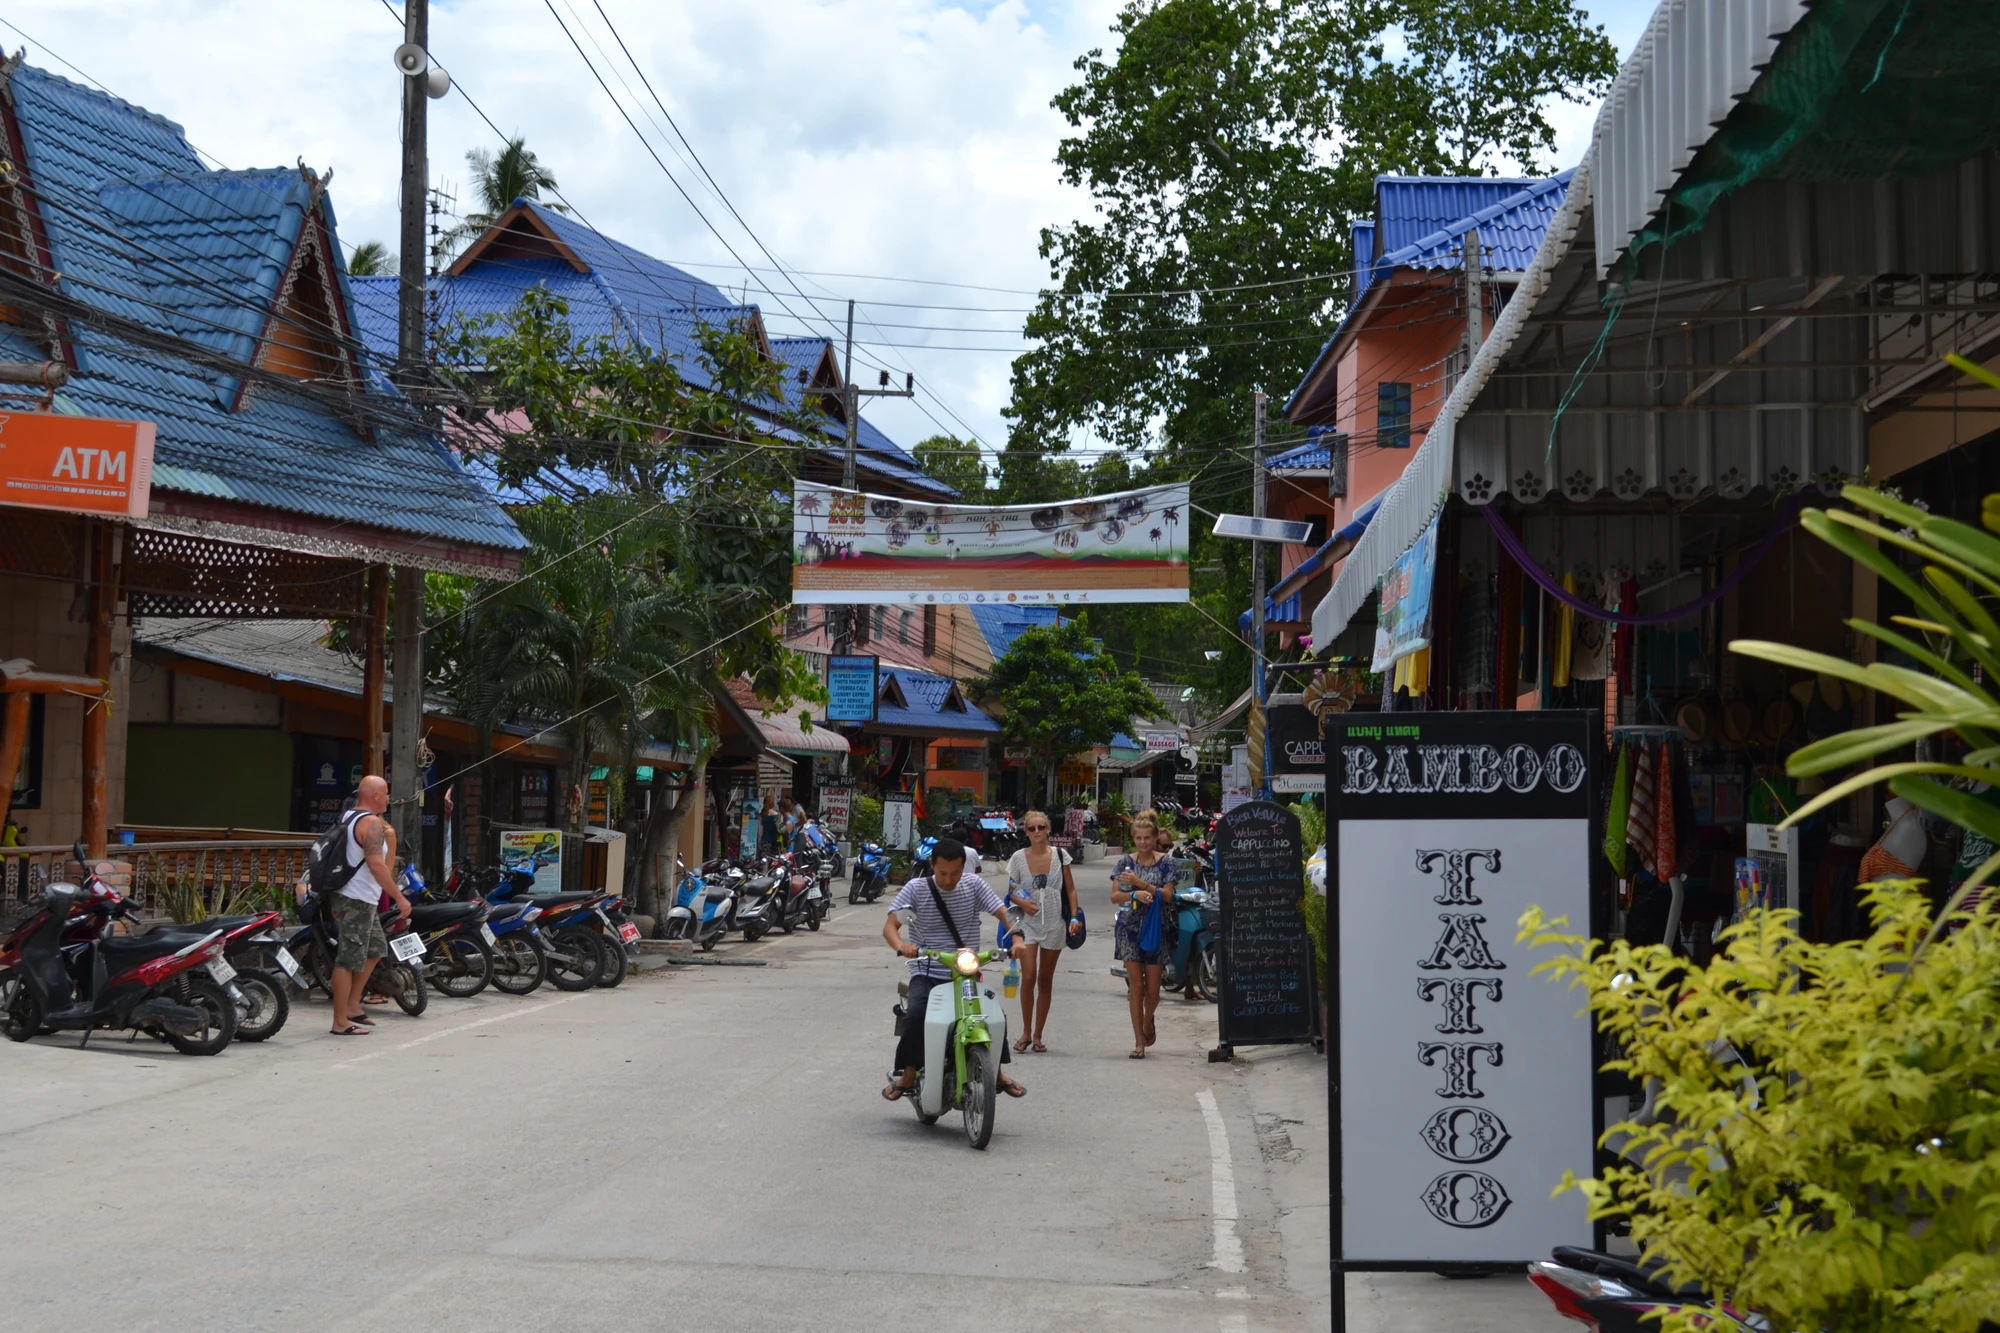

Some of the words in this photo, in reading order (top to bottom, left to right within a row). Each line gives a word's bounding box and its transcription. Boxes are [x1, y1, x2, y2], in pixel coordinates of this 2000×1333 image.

[52, 446, 126, 482] ATM
[829, 498, 865, 510] JUNE
[828, 509, 865, 524] 2015
[1341, 743, 1586, 794] BAMBOO
[817, 775, 828, 784] BIKE
[841, 777, 856, 785] RENT
[823, 788, 849, 796] LAUNDRY
[886, 793, 912, 802] BAMBOO
[821, 806, 848, 817] LAUNDRY
[1069, 811, 1083, 819] 120
[892, 803, 903, 846] TATTOO
[1065, 819, 1084, 835] 150
[1234, 826, 1269, 838] Welcome
[1270, 824, 1283, 836] To
[403, 947, 418, 957] 234
[1416, 848, 1512, 1229] TATTOO
